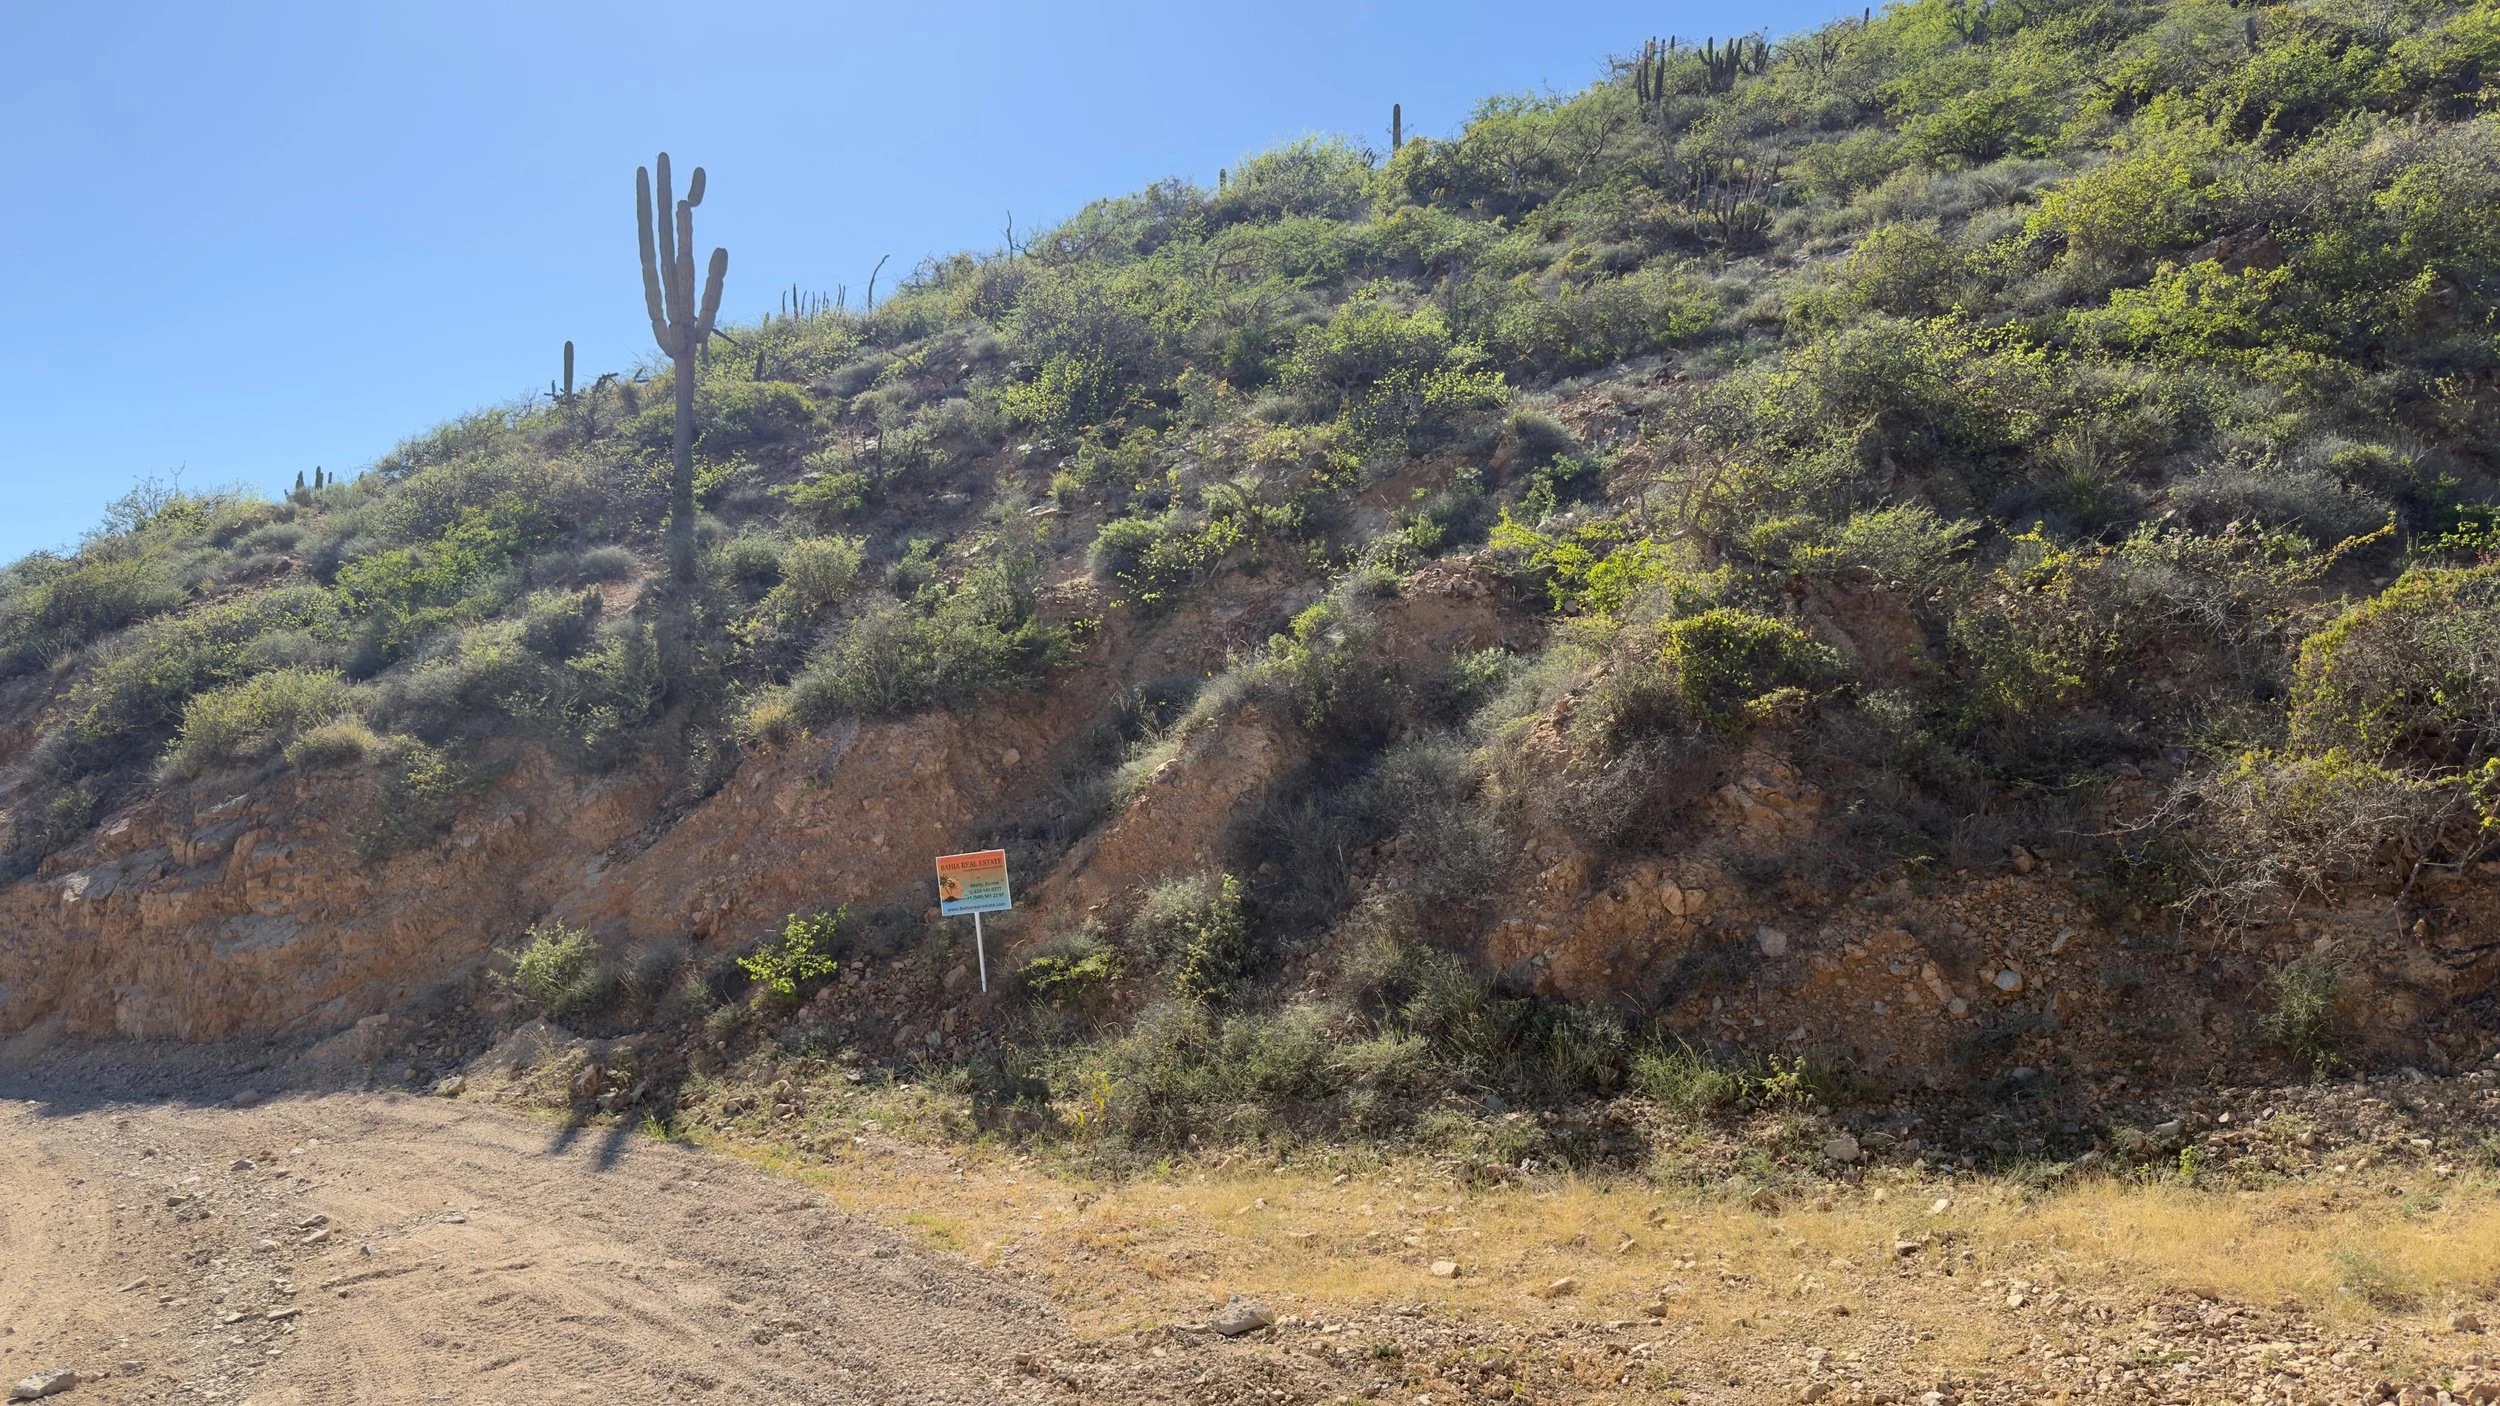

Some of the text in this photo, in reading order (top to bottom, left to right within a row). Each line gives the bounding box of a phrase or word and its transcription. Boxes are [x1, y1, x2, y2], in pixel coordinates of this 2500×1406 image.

[940, 863, 960, 871] BAHIA
[961, 860, 977, 868] REAL
[979, 858, 1003, 866] ESTATE
